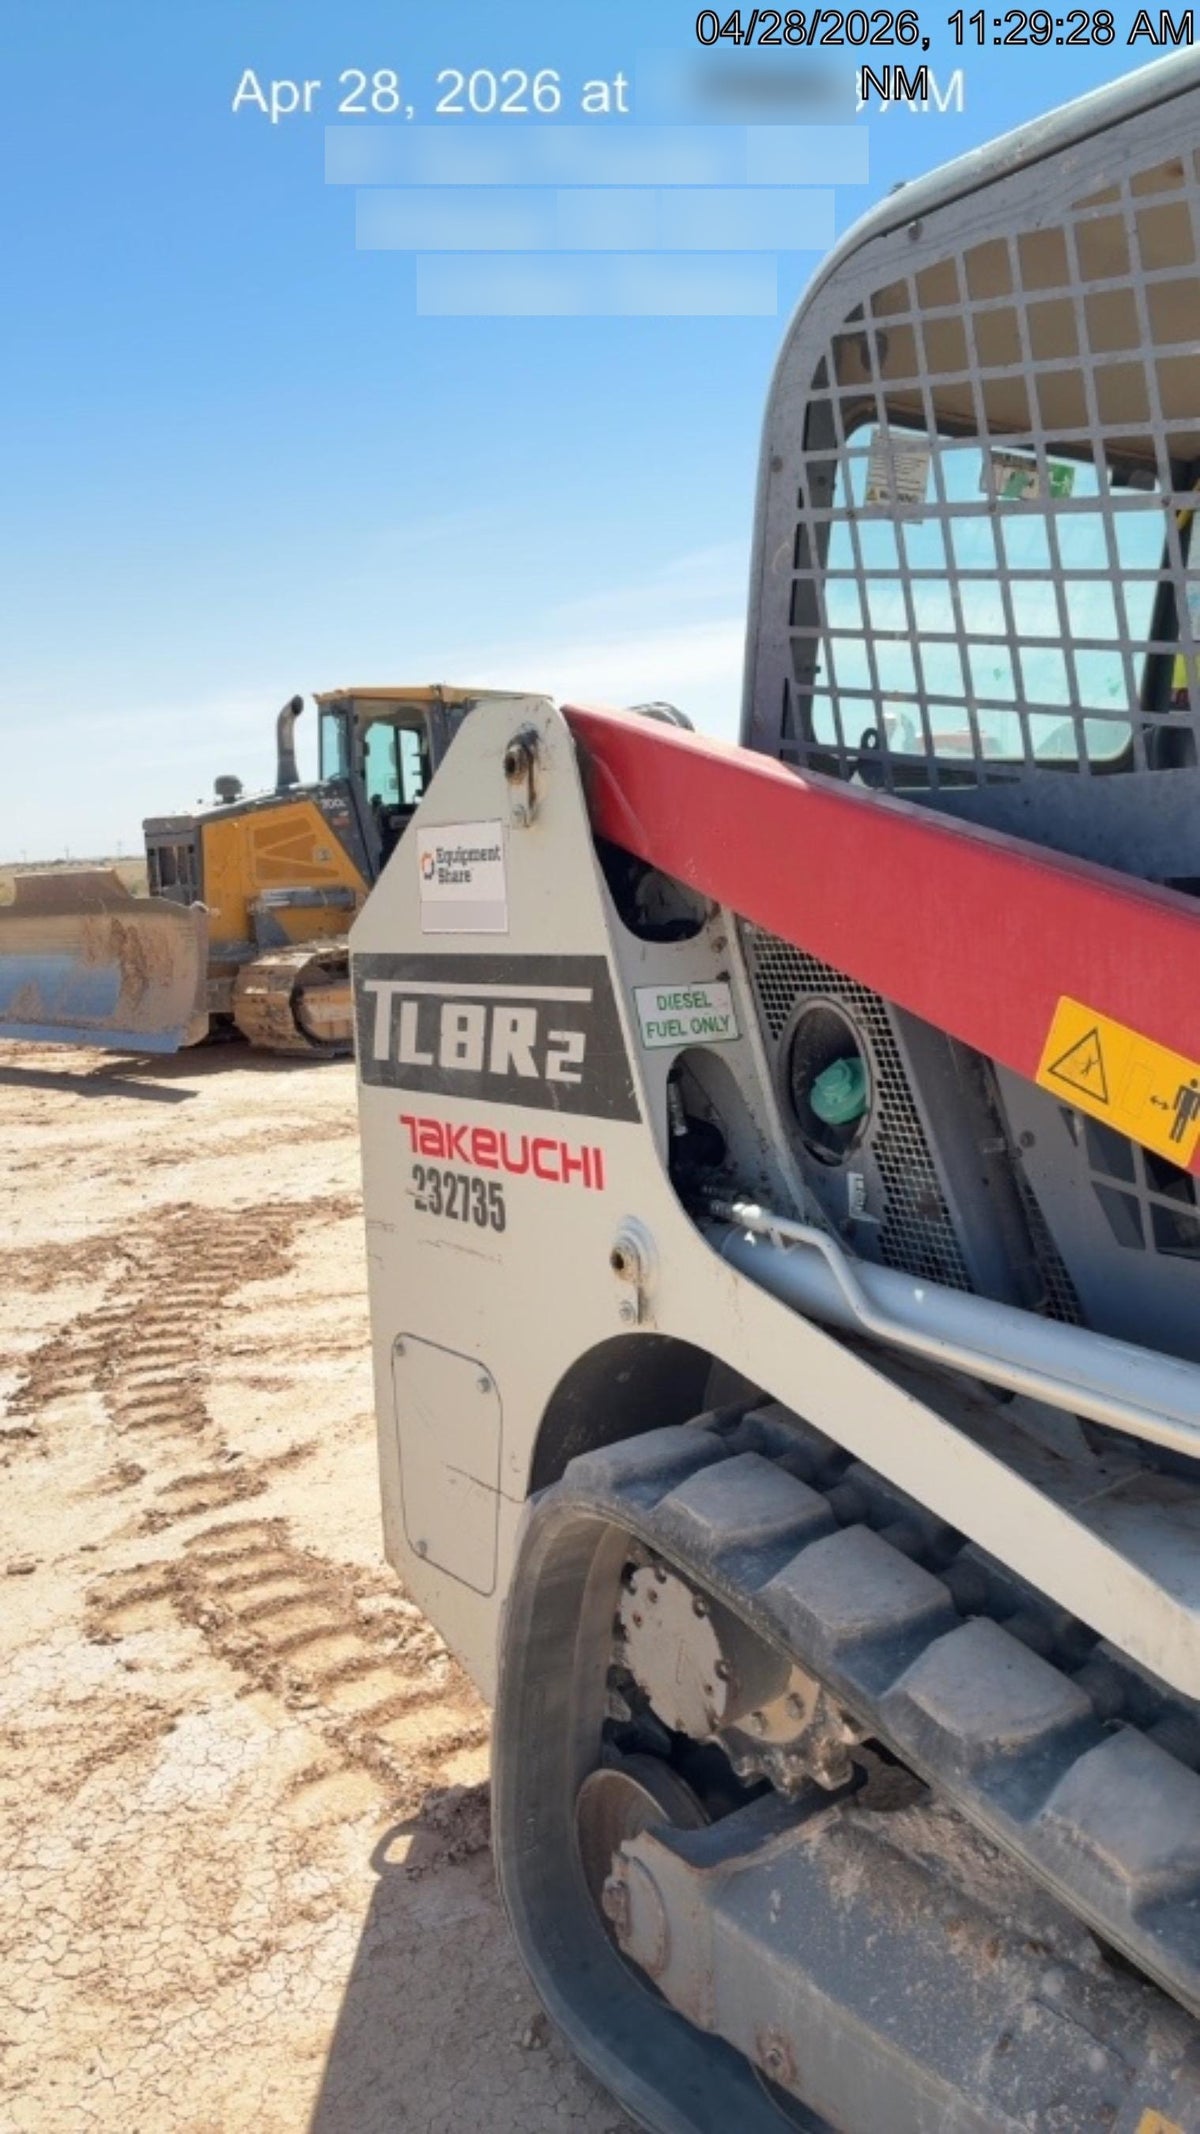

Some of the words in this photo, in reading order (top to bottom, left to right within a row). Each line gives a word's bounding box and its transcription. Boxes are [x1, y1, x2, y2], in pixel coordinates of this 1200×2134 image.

[435, 844, 501, 867] Equipment
[437, 867, 473, 883] Share
[656, 991, 712, 1011] DIESEL
[364, 980, 593, 1083] TL8R2
[645, 1018, 688, 1039] FUEL
[690, 1014, 731, 1034] ONLY
[411, 1163, 506, 1233] 232735
